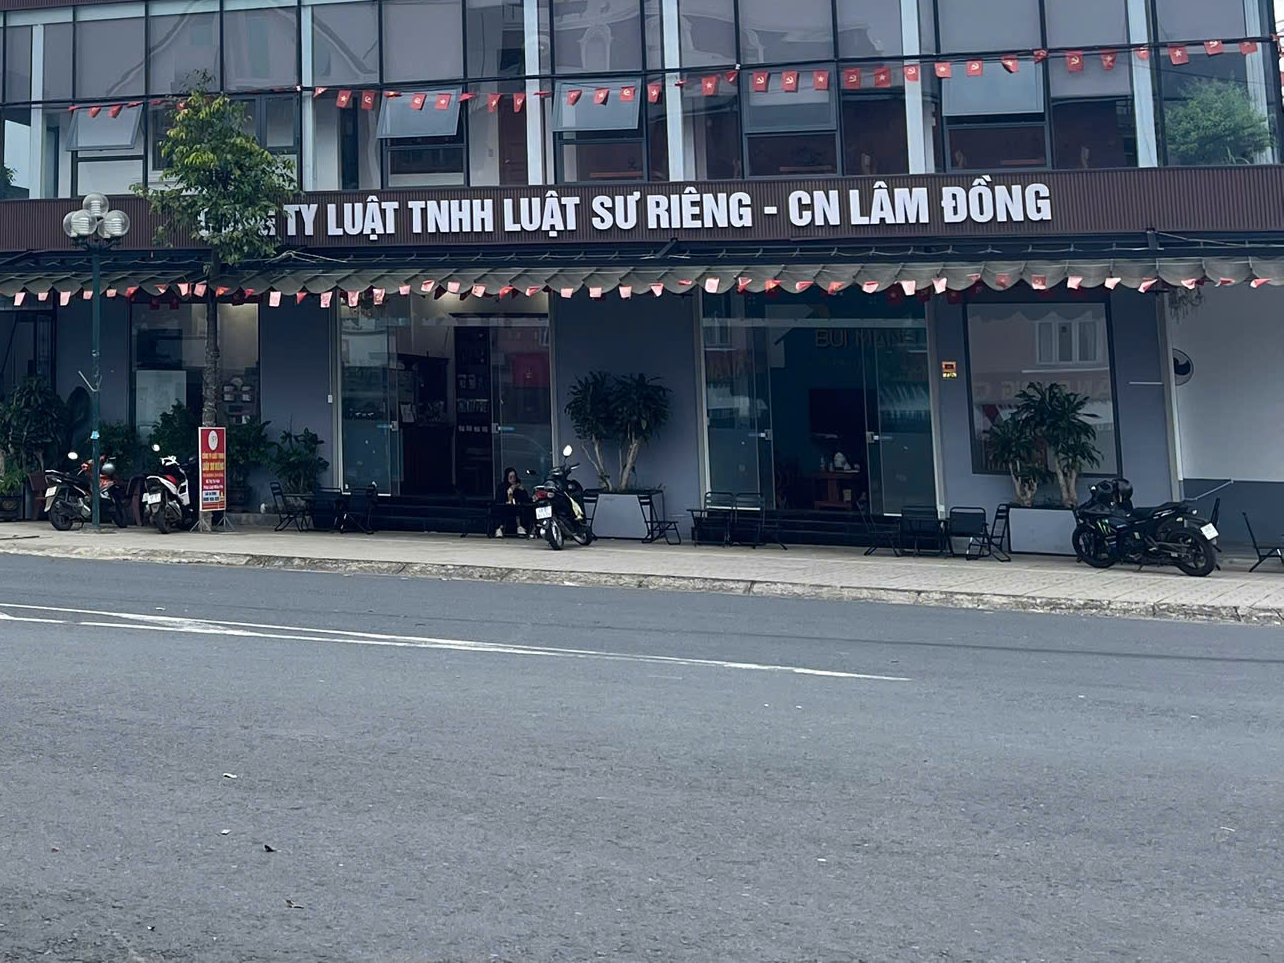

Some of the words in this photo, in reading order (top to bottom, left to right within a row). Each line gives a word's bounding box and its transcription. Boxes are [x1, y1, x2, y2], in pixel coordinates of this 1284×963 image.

[284, 204, 317, 237] TY
[327, 195, 399, 241] LUẬT
[408, 198, 494, 234] TNHH
[504, 190, 580, 238] LUẬT
[591, 190, 641, 231] SƯ
[648, 186, 752, 229] RIÊNG
[788, 189, 840, 227] CN
[849, 180, 930, 225] LÂM
[941, 174, 1052, 223] ĐỒNG
